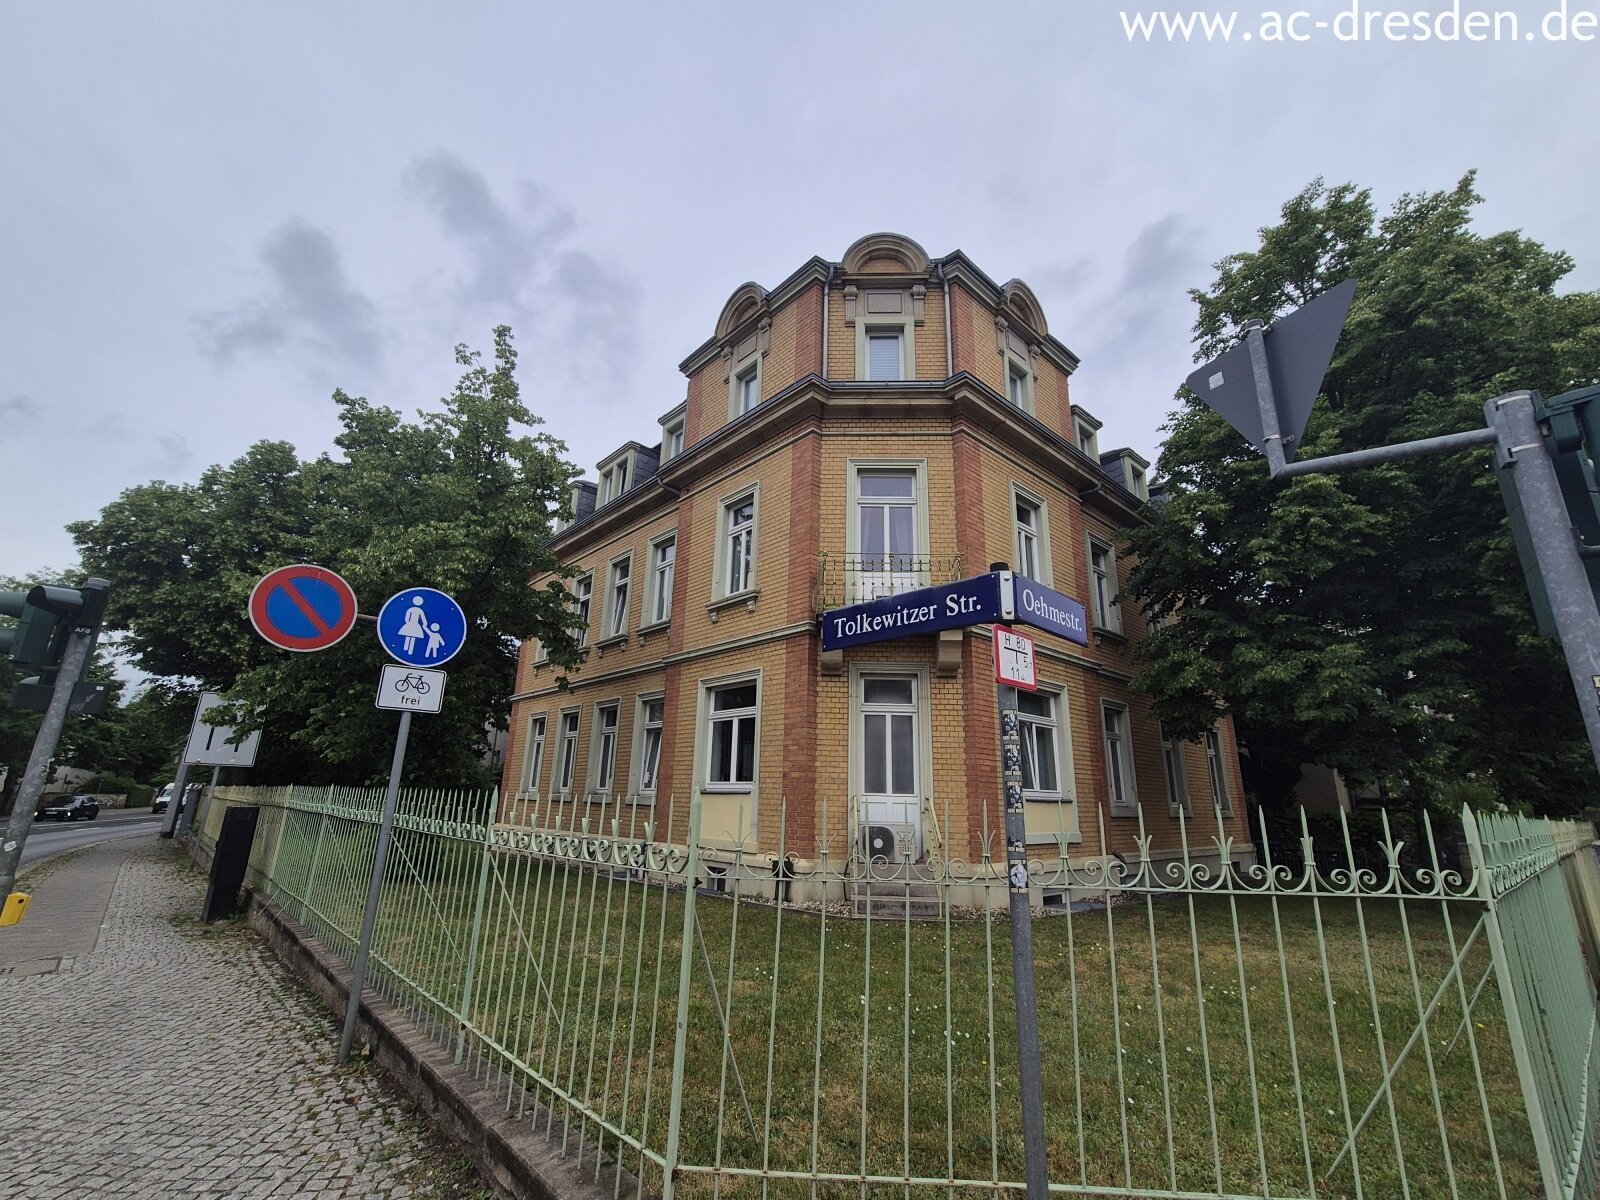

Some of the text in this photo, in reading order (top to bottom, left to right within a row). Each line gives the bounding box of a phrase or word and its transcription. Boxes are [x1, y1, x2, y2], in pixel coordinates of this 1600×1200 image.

[833, 592, 982, 638] Tolkewitzer Str.
[1022, 589, 1083, 632] Oehmestr.
[1004, 633, 1026, 650] H 80
[401, 695, 421, 705] frei
